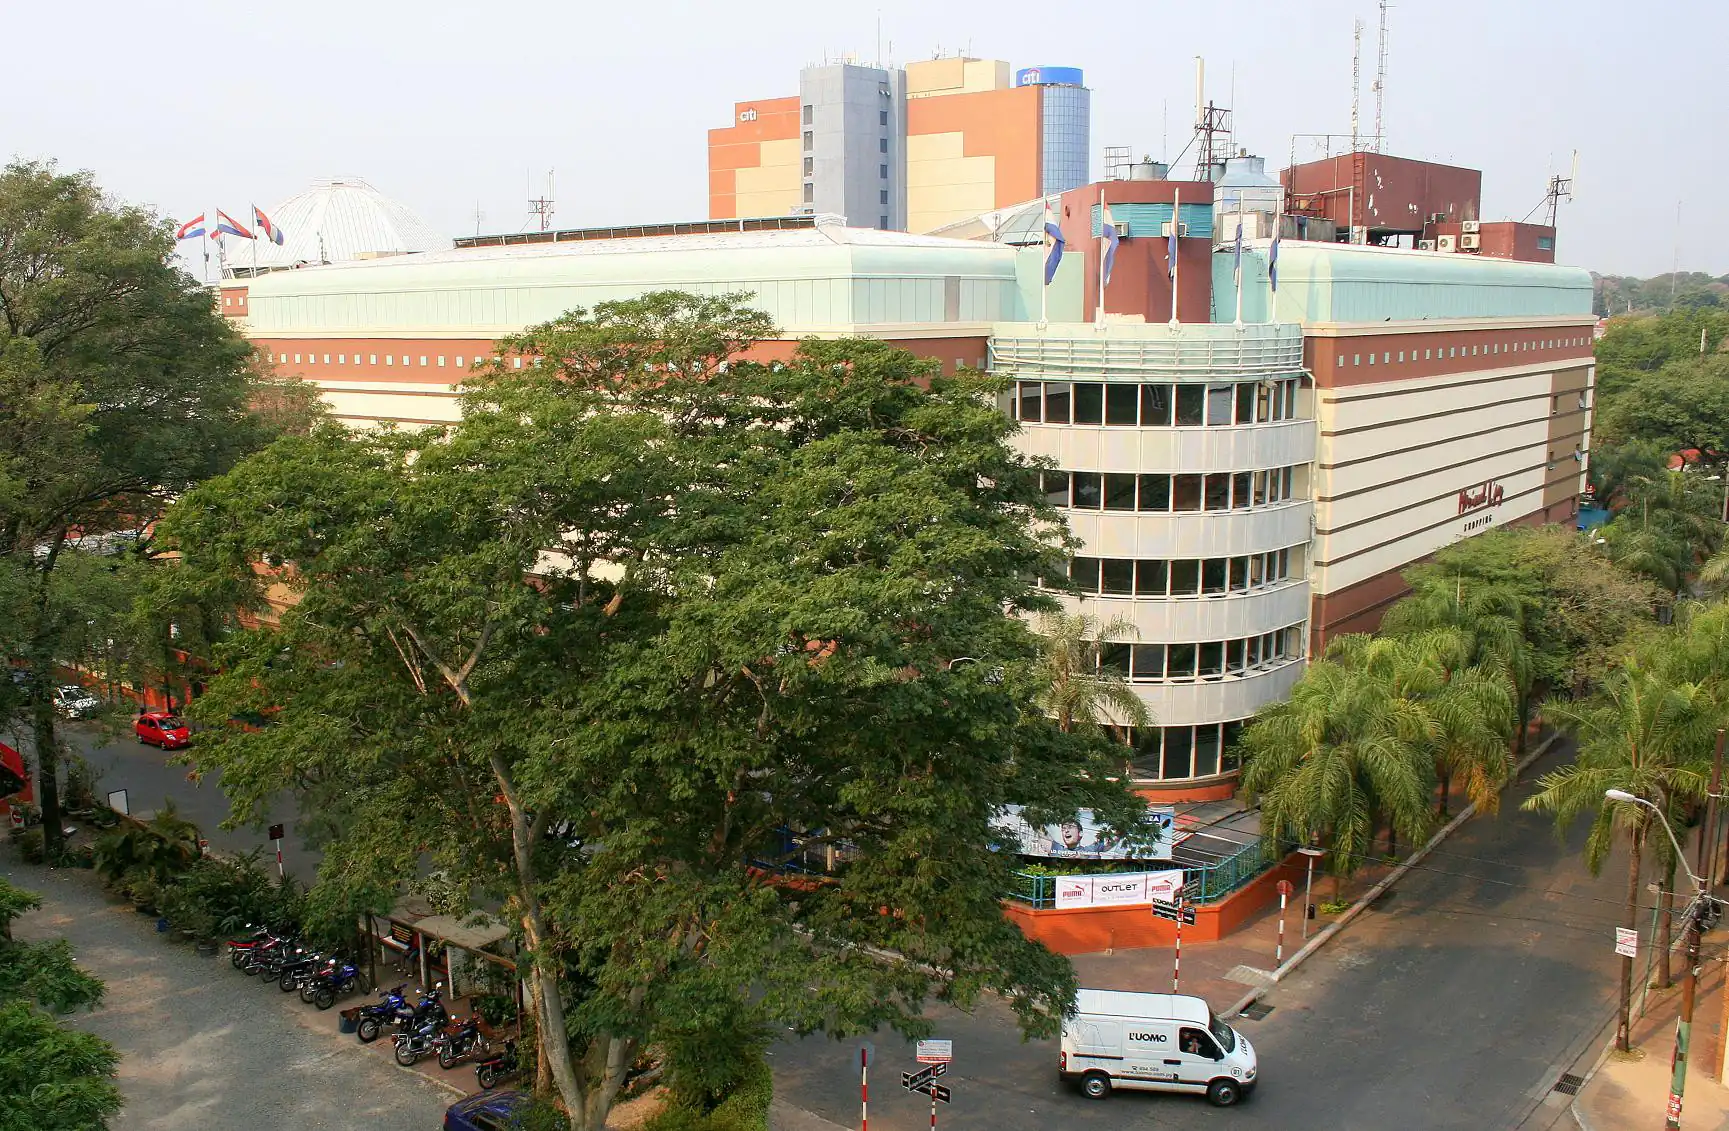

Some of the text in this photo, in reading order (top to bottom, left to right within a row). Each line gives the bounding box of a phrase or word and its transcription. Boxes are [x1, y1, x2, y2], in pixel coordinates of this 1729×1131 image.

[1022, 70, 1040, 84] citi
[739, 108, 757, 121] citi
[1062, 890, 1082, 898] PUMA
[1128, 1032, 1168, 1043] L'UOMO
